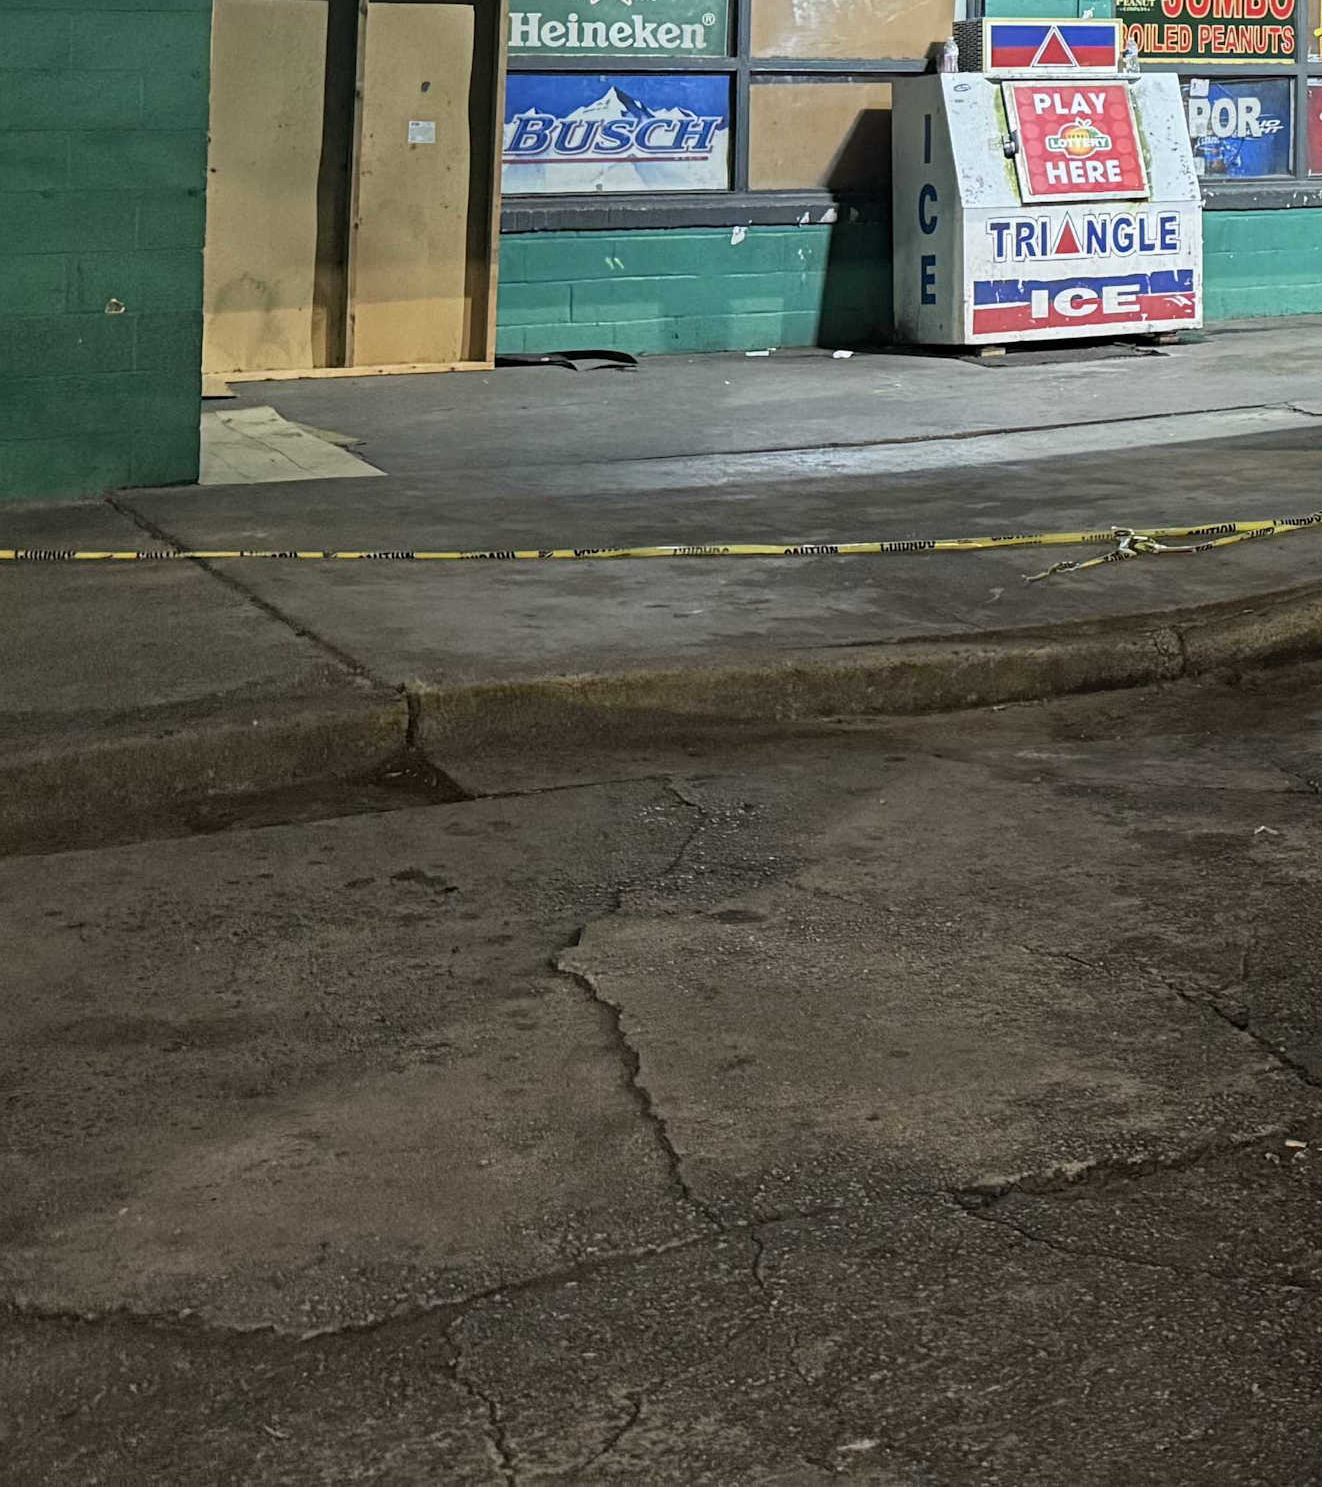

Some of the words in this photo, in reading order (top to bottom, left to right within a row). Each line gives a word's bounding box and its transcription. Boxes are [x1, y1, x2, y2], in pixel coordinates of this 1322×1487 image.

[507, 12, 707, 49] Heineken
[1197, 24, 1296, 55] PEANUTS
[1033, 92, 1107, 115] PLAY
[504, 115, 721, 155] BUSCH
[1046, 159, 1123, 185] HERE
[1031, 283, 1141, 319] ICE
